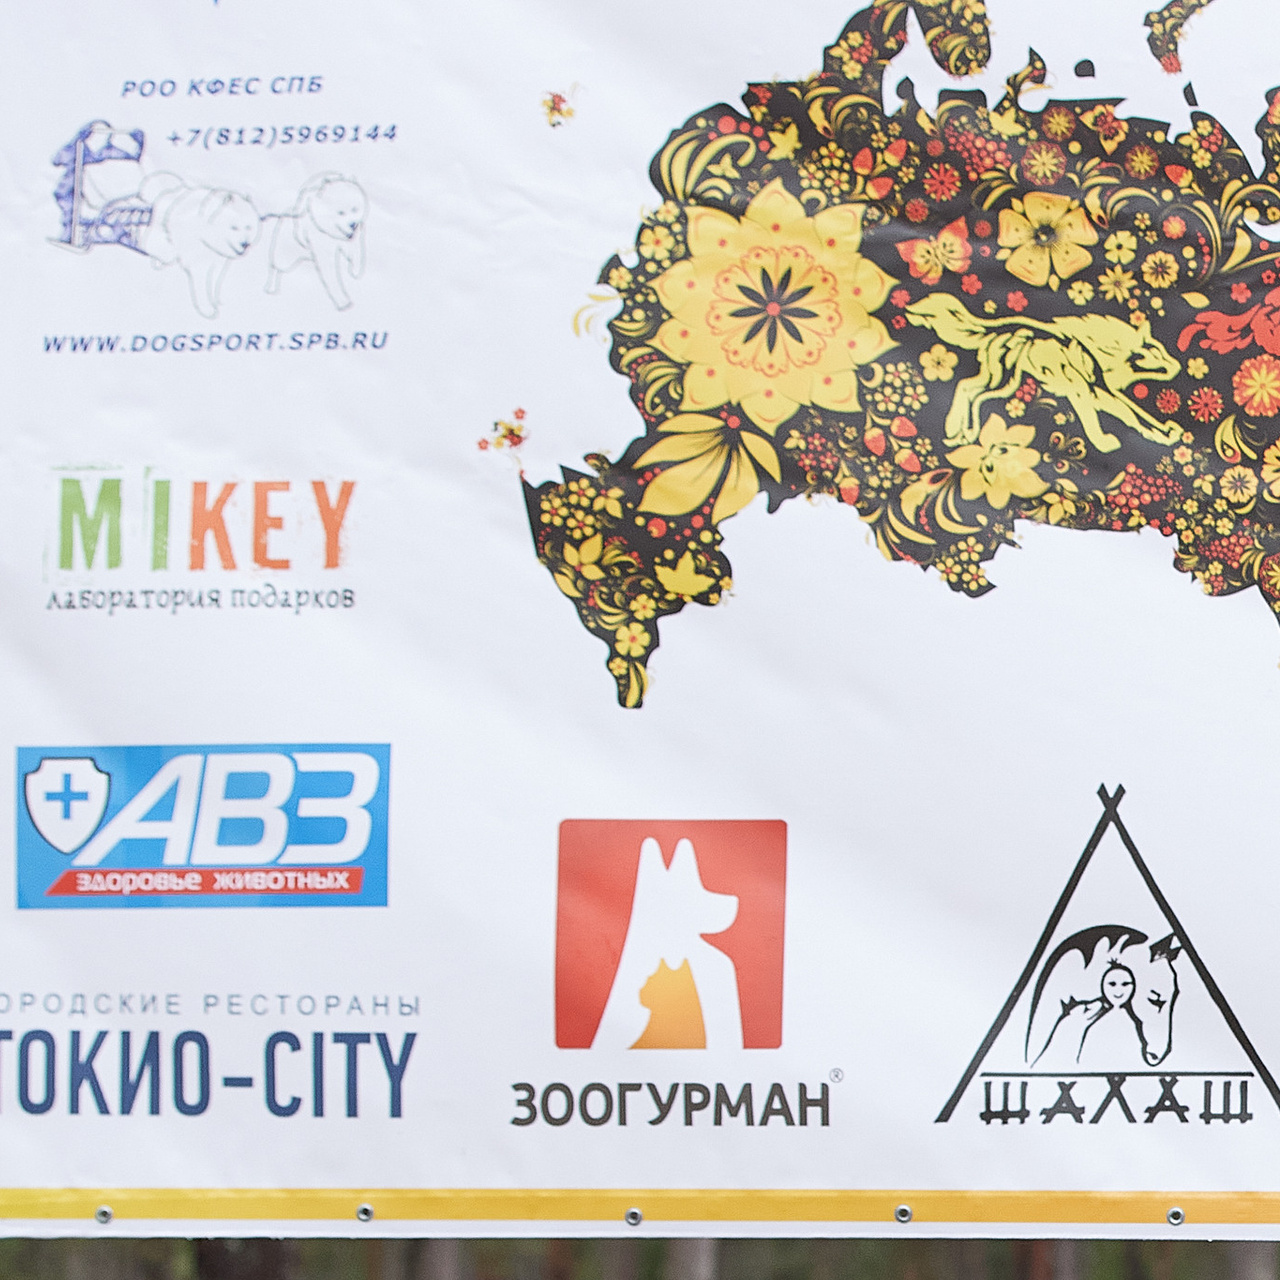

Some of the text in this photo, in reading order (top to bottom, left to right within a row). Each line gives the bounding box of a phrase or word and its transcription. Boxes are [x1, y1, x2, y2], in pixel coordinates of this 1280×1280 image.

[122, 76, 323, 97] РОО КФЕС СПБ
[168, 125, 398, 149] +7(812)5969144
[44, 332, 388, 353] WWW.DOGSPORT.SPB.RU
[59, 479, 355, 570] MIKEY
[46, 584, 355, 615] лаборатория подарков
[70, 752, 380, 865] АВЗ
[213, 871, 350, 891] животных
[204, 995, 420, 1017] РЕСТОРАНЫ
[511, 1083, 830, 1126] ЗООГУРМАН
